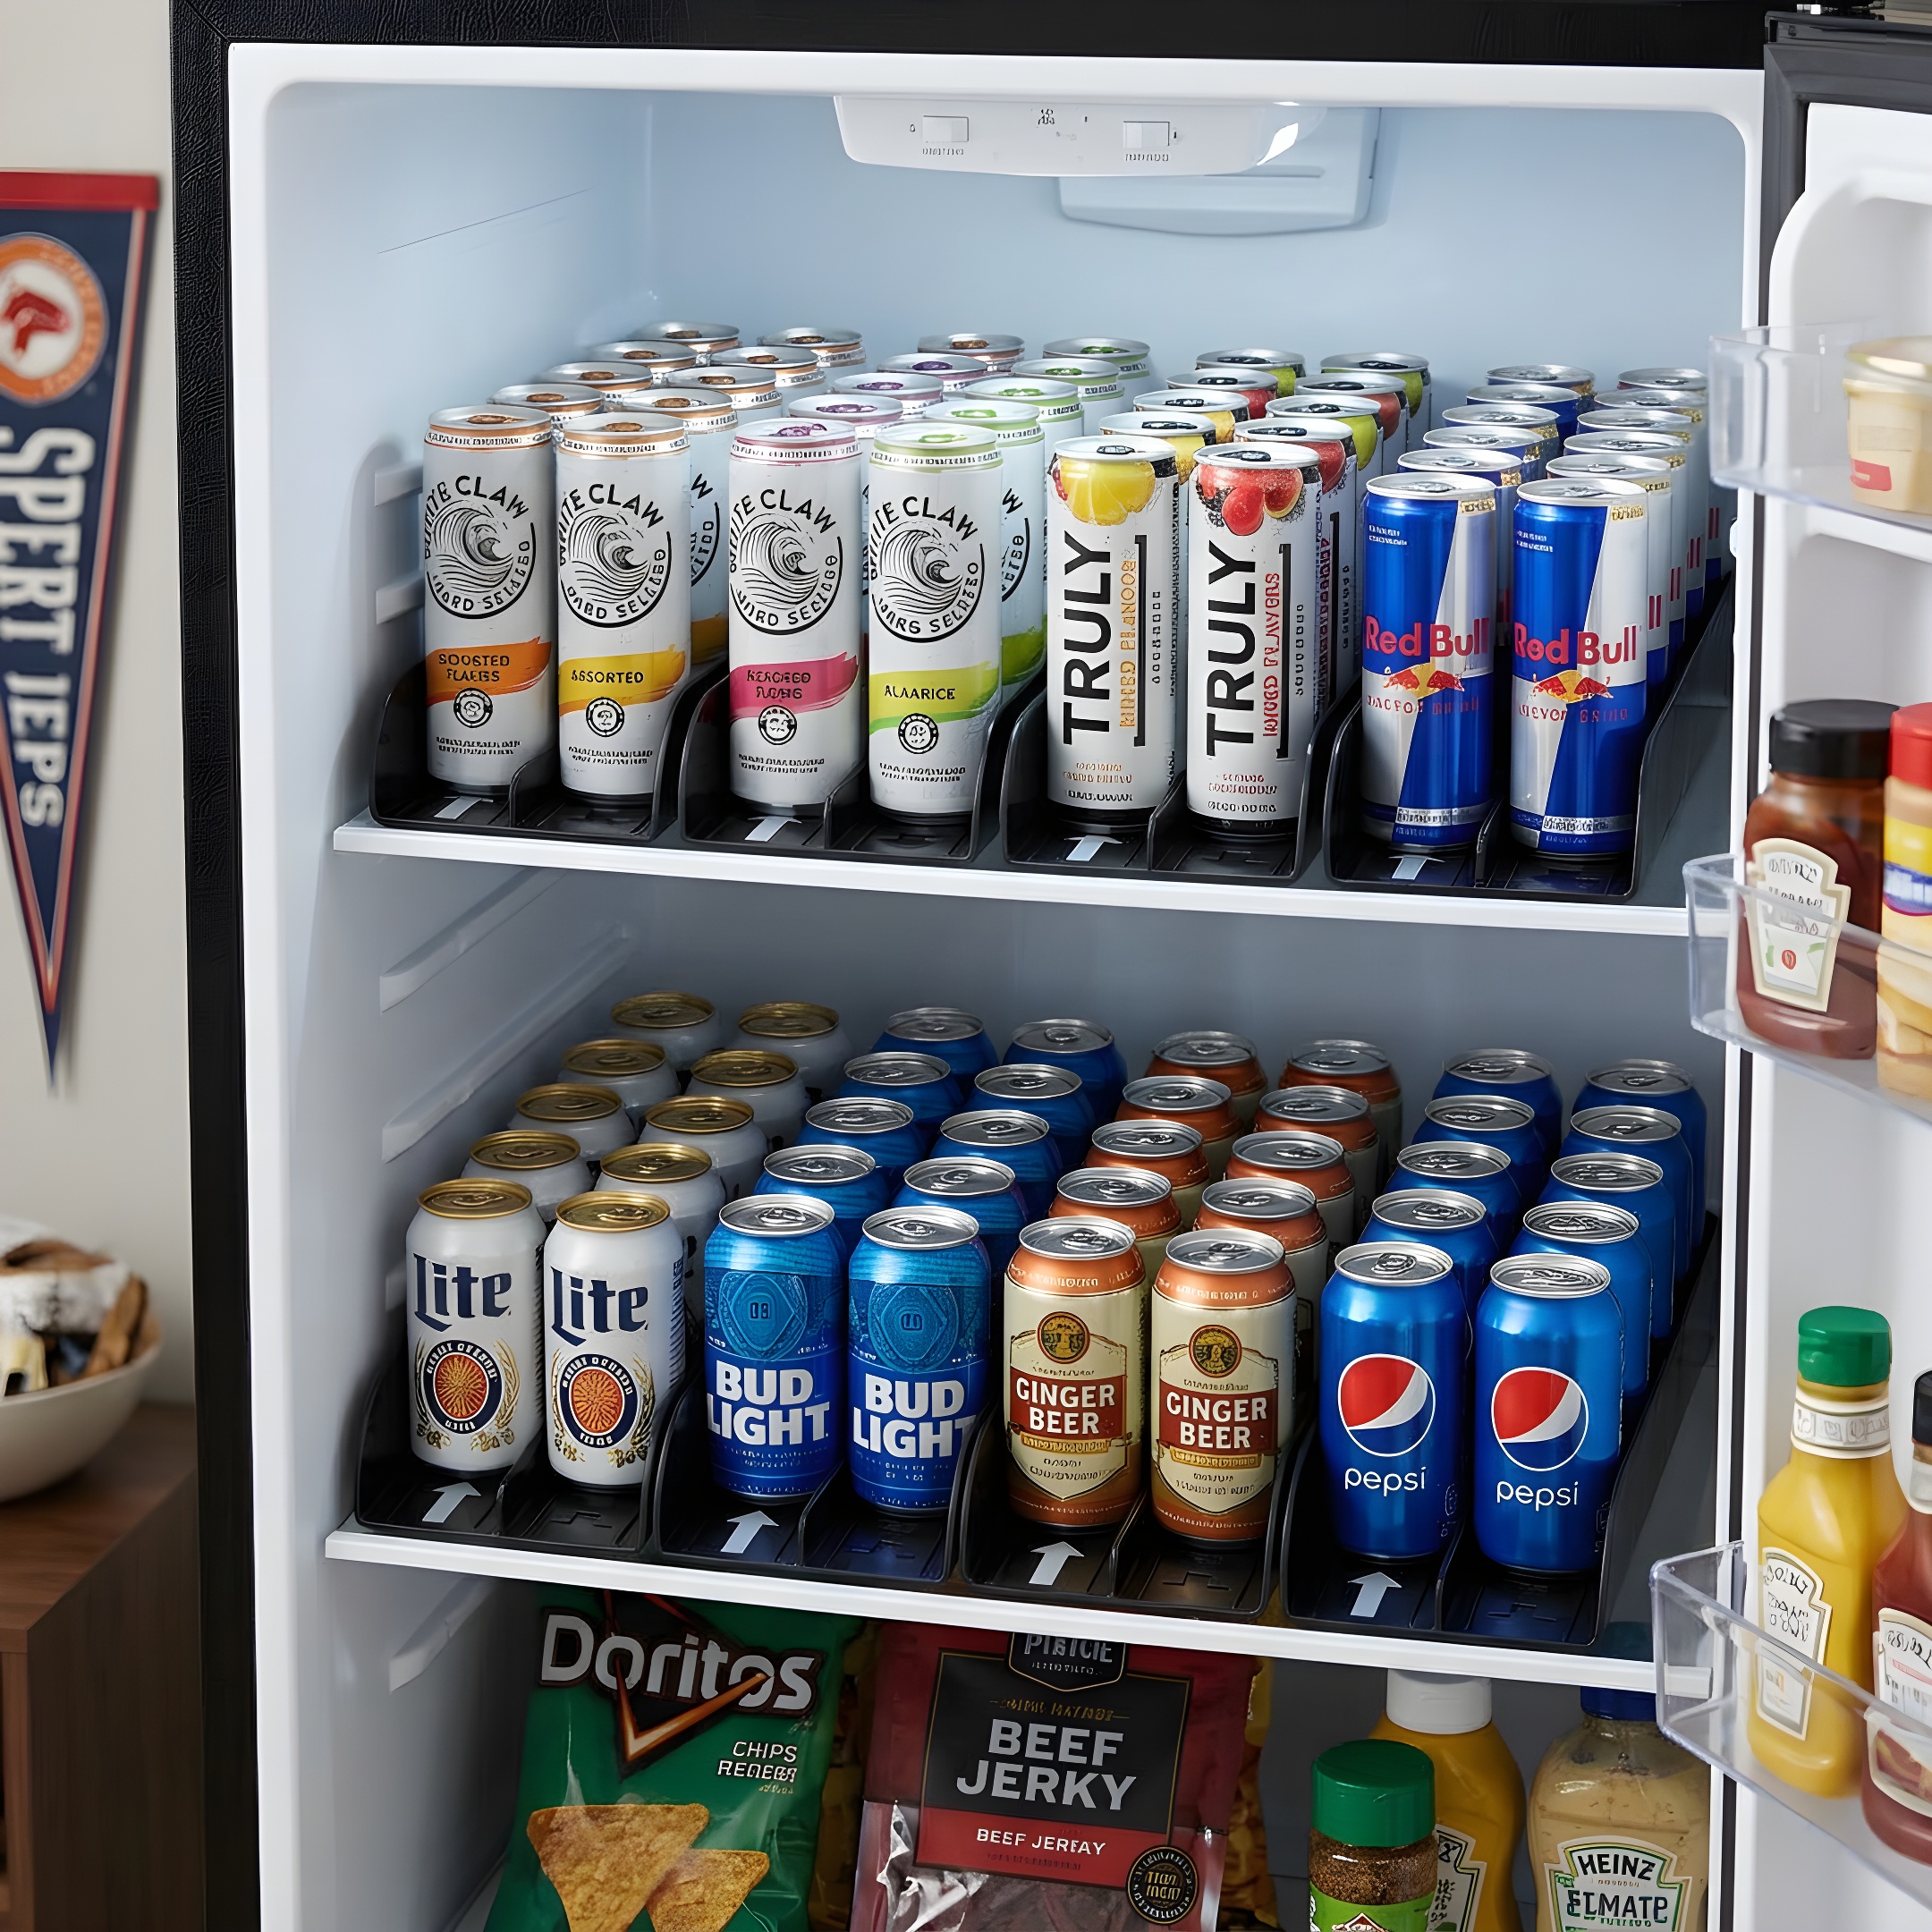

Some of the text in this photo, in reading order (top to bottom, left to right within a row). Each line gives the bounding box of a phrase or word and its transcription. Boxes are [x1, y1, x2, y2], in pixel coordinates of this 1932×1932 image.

[455, 475, 530, 519] CLAW
[589, 483, 665, 529] CLAW
[760, 489, 836, 534] CLAW
[902, 496, 979, 541] CLAW
[1063, 530, 1112, 746] TRULY
[1207, 539, 1257, 758] TRULY
[1365, 614, 1490, 657] Red Bull
[1513, 623, 1637, 665] Red Bull
[413, 1252, 513, 1333] Lite
[550, 1266, 649, 1347] Lite
[716, 1360, 814, 1406] BUD
[865, 1373, 965, 1419] BUD
[1016, 1377, 1115, 1408] GINGER
[707, 1393, 830, 1446] LIGHT
[1030, 1406, 1100, 1435] BEER
[1166, 1391, 1267, 1423] GINGER
[853, 1406, 978, 1460] LIGHT
[1180, 1420, 1251, 1449] BEER
[1344, 1466, 1427, 1497] pepsi
[1496, 1480, 1579, 1512] pepsi
[540, 1613, 816, 1710] Doritos
[733, 1741, 798, 1763] CHIPS
[987, 1717, 1124, 1767] BEEF
[955, 1758, 1137, 1811] JERKY
[976, 1827, 1027, 1847] BEEF
[1577, 1853, 1657, 1881] HEINZ
